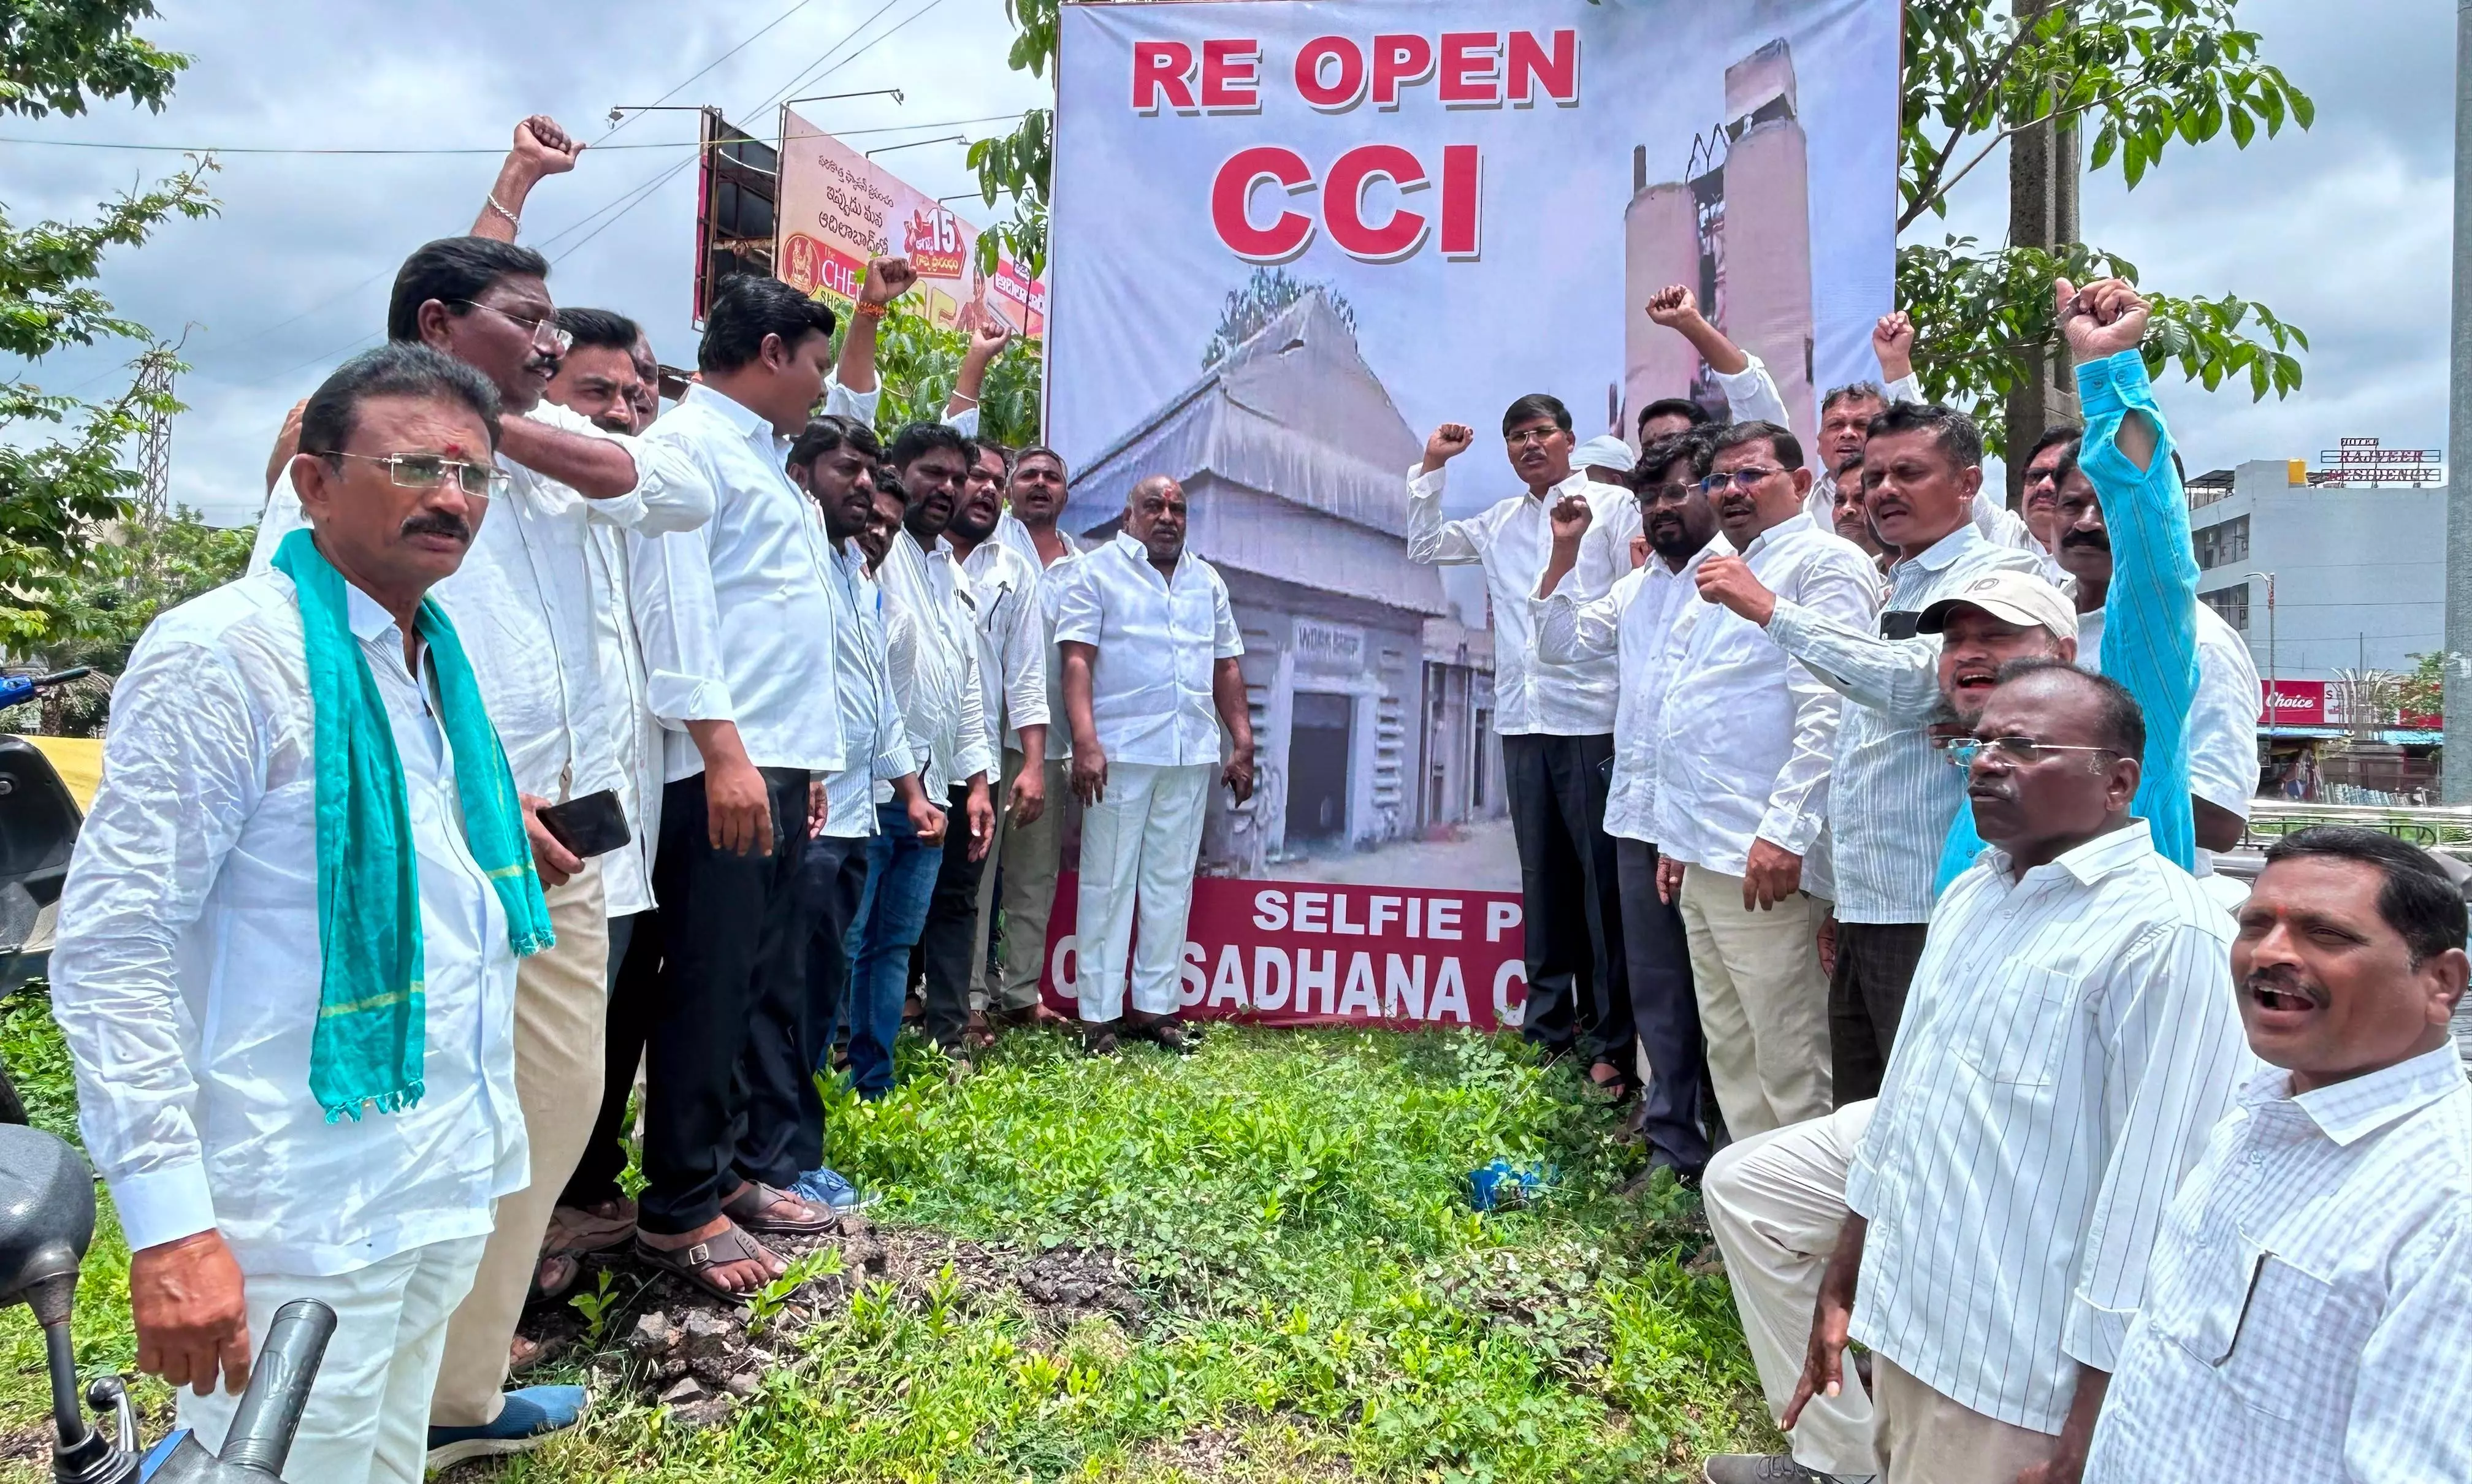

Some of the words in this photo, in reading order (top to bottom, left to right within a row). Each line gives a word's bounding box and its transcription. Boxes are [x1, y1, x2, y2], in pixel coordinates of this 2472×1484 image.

[1132, 39, 1261, 116] RE
[1294, 29, 1580, 114] OPEN
[926, 207, 956, 254] 15
[1211, 143, 1483, 264] CCI
[2265, 691, 2314, 709] Choice
[1252, 889, 1463, 940] SELFIE
[1180, 941, 1470, 1022] SADHANA
